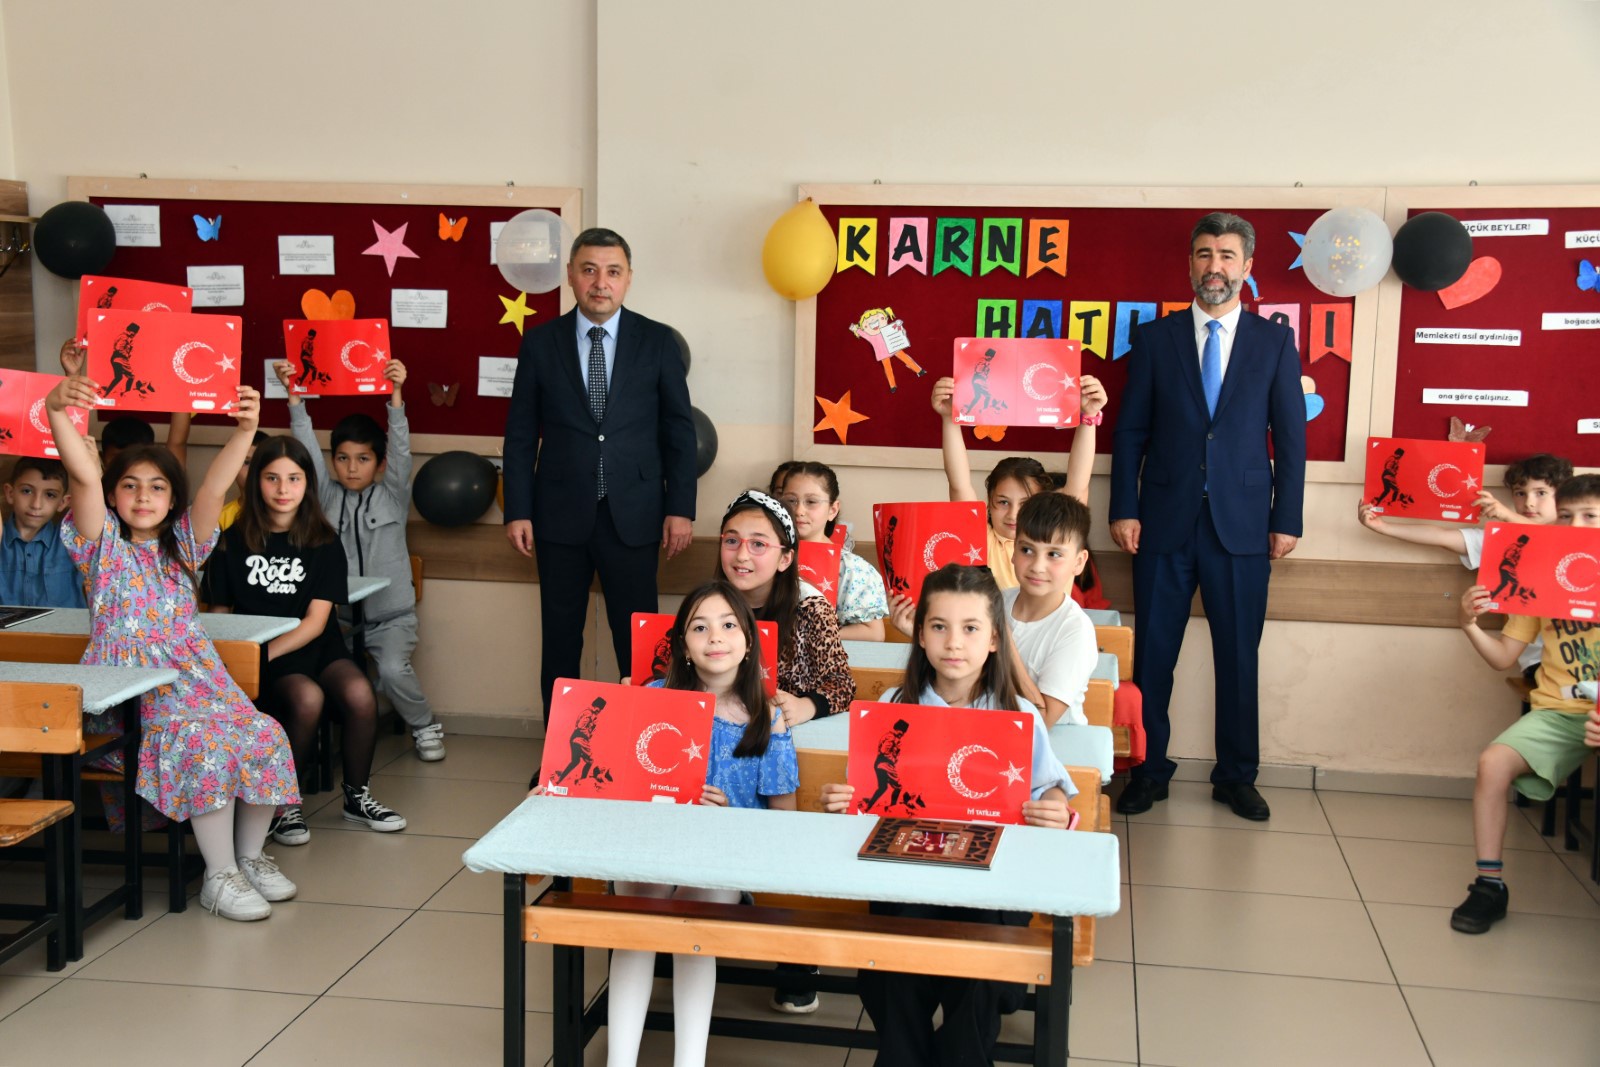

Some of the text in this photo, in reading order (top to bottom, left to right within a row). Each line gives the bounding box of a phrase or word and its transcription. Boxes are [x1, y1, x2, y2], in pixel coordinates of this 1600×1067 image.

[1490, 223, 1531, 232] BEYLER!
[845, 223, 1061, 264] KARNE
[984, 306, 1334, 349] HATII
[1416, 331, 1460, 340] Memleketi
[1454, 393, 1473, 402] göre
[245, 554, 307, 587] Rock
[266, 579, 298, 595] star
[1559, 637, 1588, 665] ON
